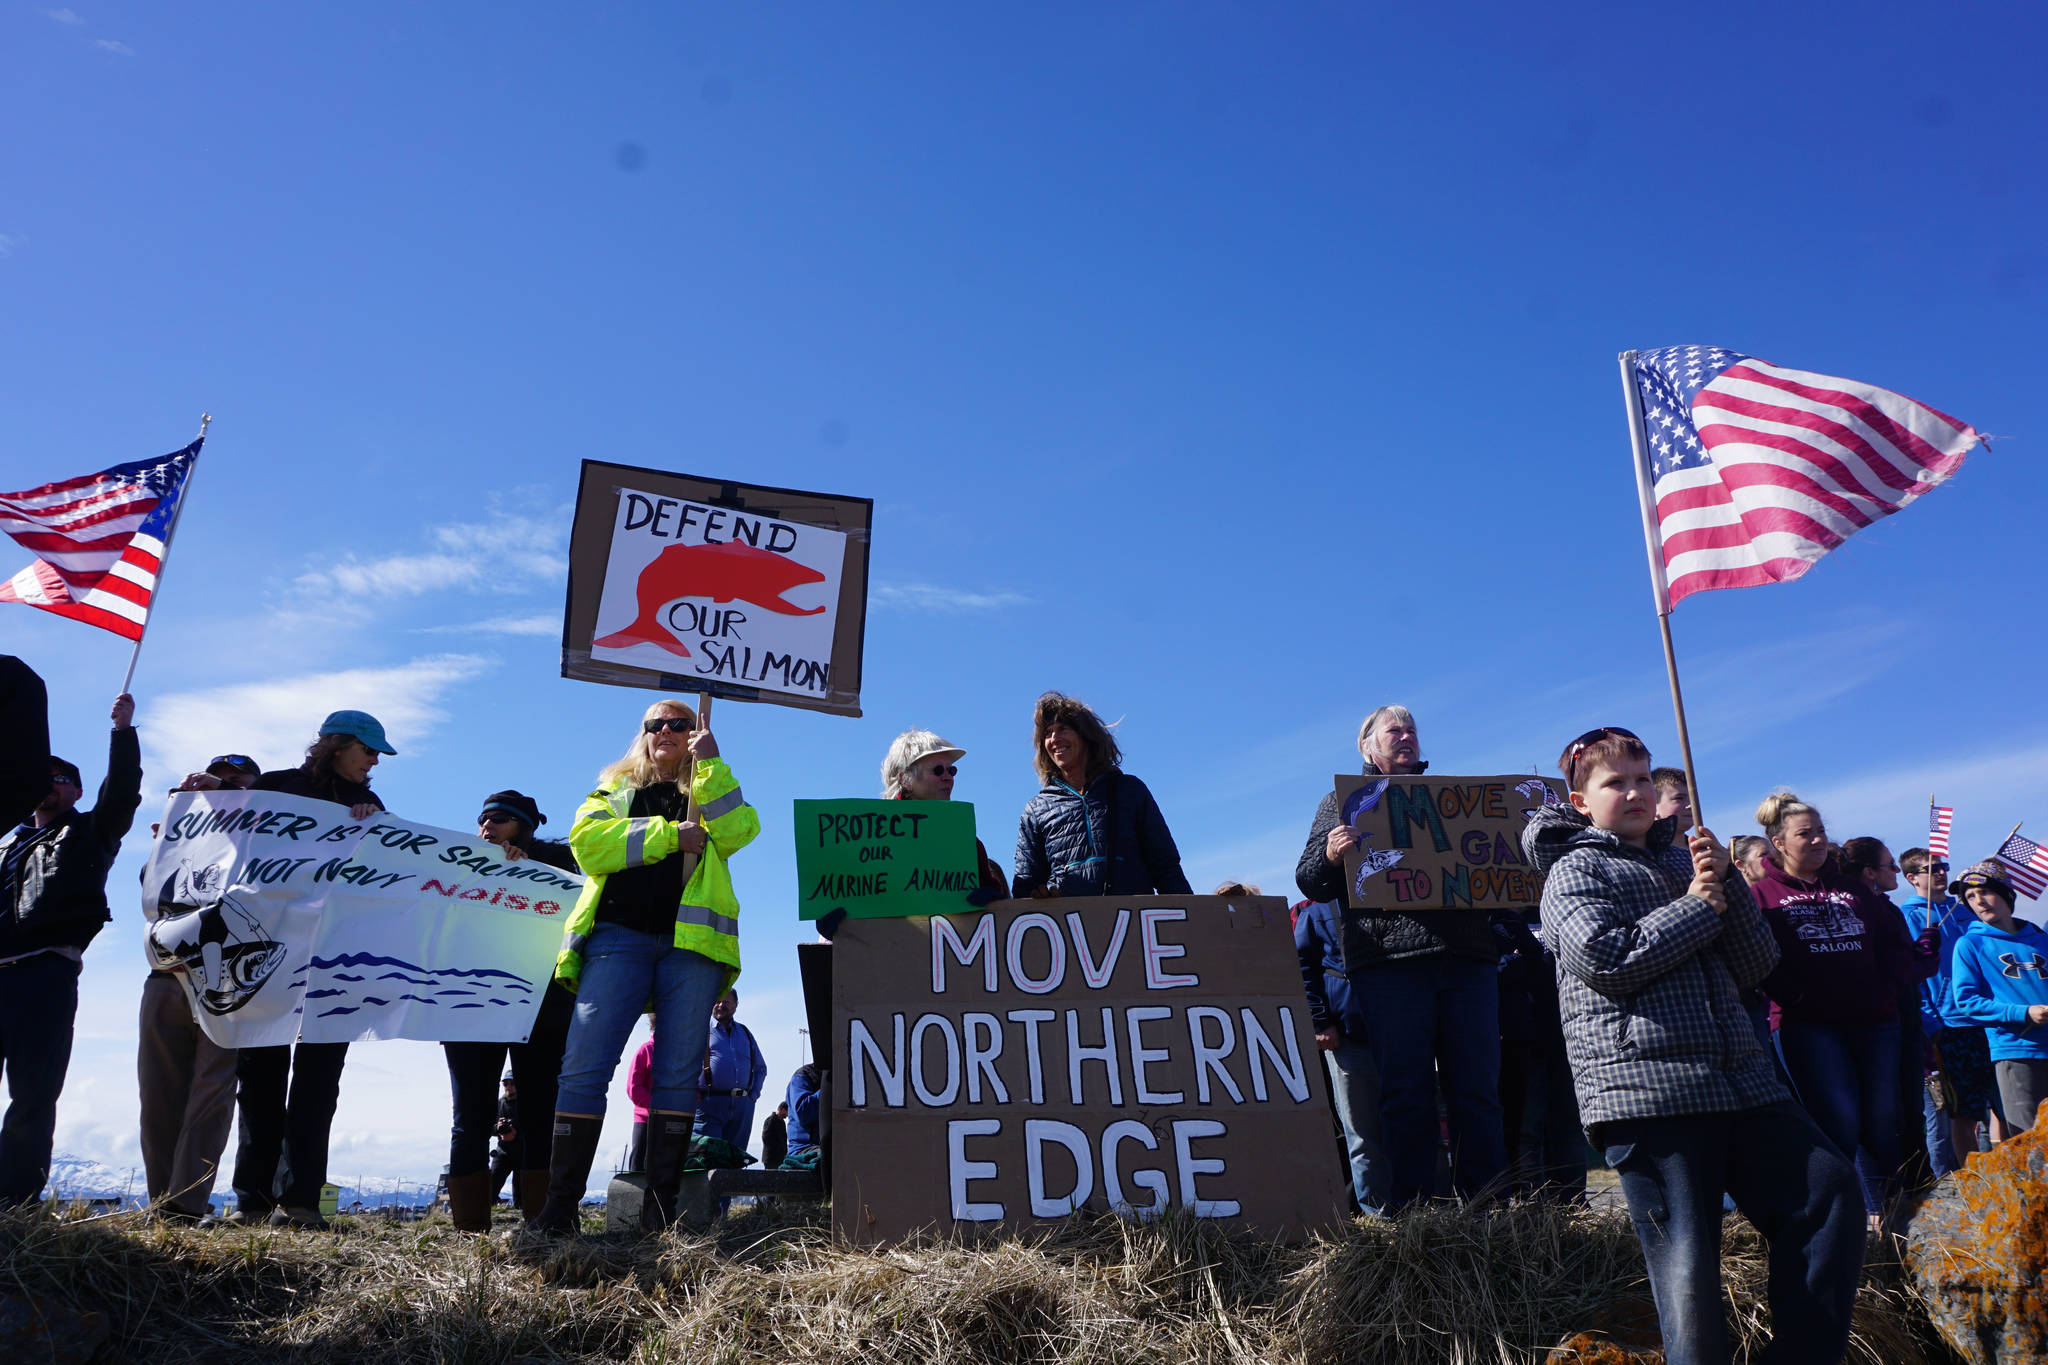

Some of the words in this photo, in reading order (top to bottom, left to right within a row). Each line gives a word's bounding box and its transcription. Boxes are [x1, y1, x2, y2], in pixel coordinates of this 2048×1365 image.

[624, 493, 798, 553] DEFEND
[668, 602, 747, 640] OUR
[694, 640, 829, 692] SALMON
[817, 812, 929, 848] PROTECT
[1386, 784, 1508, 853] MOVE
[164, 807, 318, 842] SUMMER
[315, 824, 363, 842] IS
[360, 824, 438, 855] FOR
[438, 845, 584, 891] SALMON
[859, 846, 894, 863] OUR
[235, 858, 317, 885] NOT
[313, 858, 417, 889] NAVY
[807, 872, 889, 901] MARINE
[904, 867, 978, 892] ANIMALS
[1386, 868, 1432, 902] TO
[929, 907, 1200, 995] MOVE
[1809, 940, 1863, 953] SALOON
[848, 1005, 1311, 1108] NORTHERN
[947, 1118, 1242, 1223] EDGE
